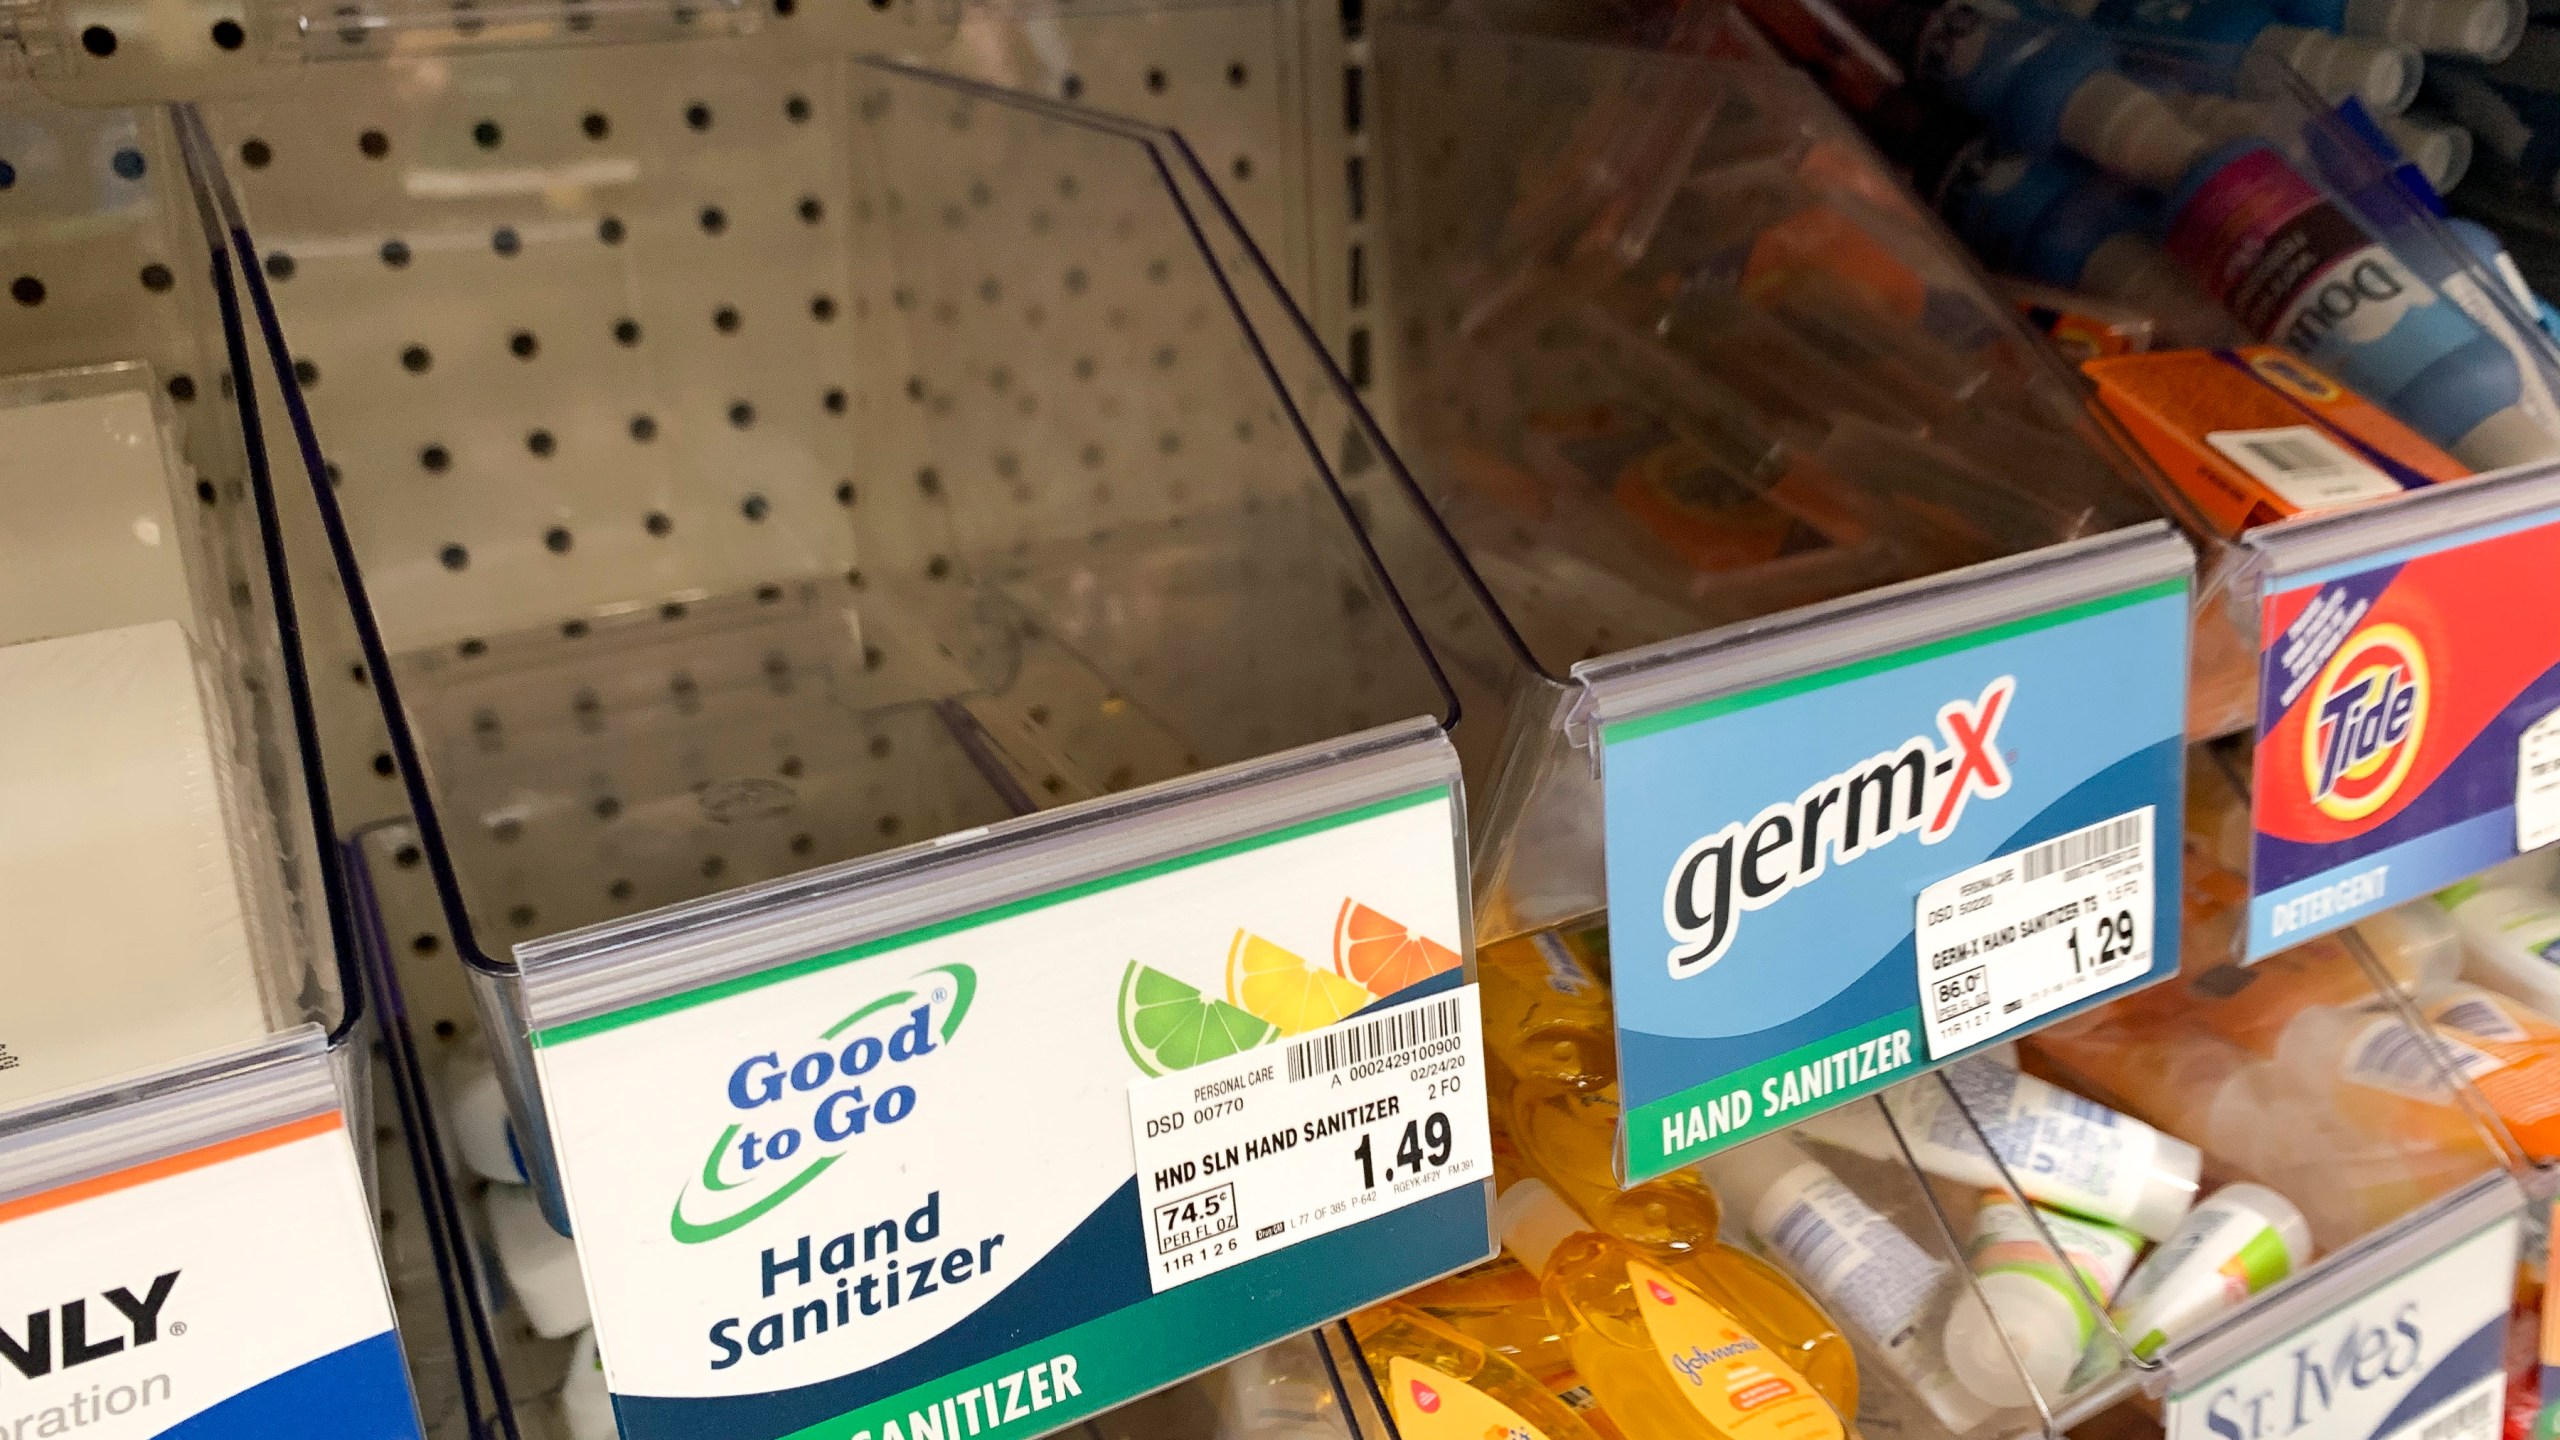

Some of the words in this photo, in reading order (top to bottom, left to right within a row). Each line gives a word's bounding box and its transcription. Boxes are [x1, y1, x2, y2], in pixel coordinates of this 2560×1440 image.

[2312, 665, 2418, 804] Tide
[1928, 904, 1953, 927] DSD
[2271, 864, 2390, 939] DETERGENT
[1932, 938, 1980, 971] GERM-X
[1982, 925, 2016, 953] HAND
[2019, 901, 2080, 939] SANITIZER
[2067, 908, 2135, 974] 1.29
[727, 1003, 938, 1110] Good
[1194, 1075, 1247, 1103] PERSONAL
[1248, 1065, 1275, 1087] CARE
[1331, 1073, 1343, 1089] A
[1350, 1036, 1461, 1082] 0002429100900
[1410, 1055, 1466, 1082] 02/24/20
[1428, 1084, 1437, 1101] 2
[1441, 1075, 1461, 1097] FO
[738, 1127, 802, 1170] to
[813, 1083, 917, 1143] Go
[1146, 1111, 1185, 1139] DSD
[1194, 1097, 1245, 1125] 00770
[1661, 1093, 1753, 1156] HAND
[1762, 1029, 1912, 1117] SANITIZER
[1155, 1161, 1197, 1192] HND
[1202, 1146, 1240, 1177] SLN
[1245, 1127, 1298, 1162] HAND
[1303, 1096, 1401, 1143] SANITIZER
[1354, 1112, 1453, 1191] 1.49
[1163, 1230, 1192, 1251] PER
[1196, 1224, 1212, 1240] FL
[1216, 1214, 1236, 1232] OZ
[1291, 1219, 1296, 1229] L
[1299, 1214, 1309, 1226] 77
[1314, 1206, 1328, 1220] OF
[1330, 1201, 1347, 1216] 385
[1351, 1192, 1377, 1208] P-642
[760, 1190, 940, 1300] Hand
[1163, 1253, 1194, 1274] 11R
[1200, 1248, 1207, 1261] 1
[1214, 1243, 1223, 1257] 2
[1228, 1238, 1238, 1251] 6
[708, 1232, 1005, 1371] Sanitizer
[0, 1373, 172, 1440] ration
[851, 1354, 1083, 1440] NITIZER
